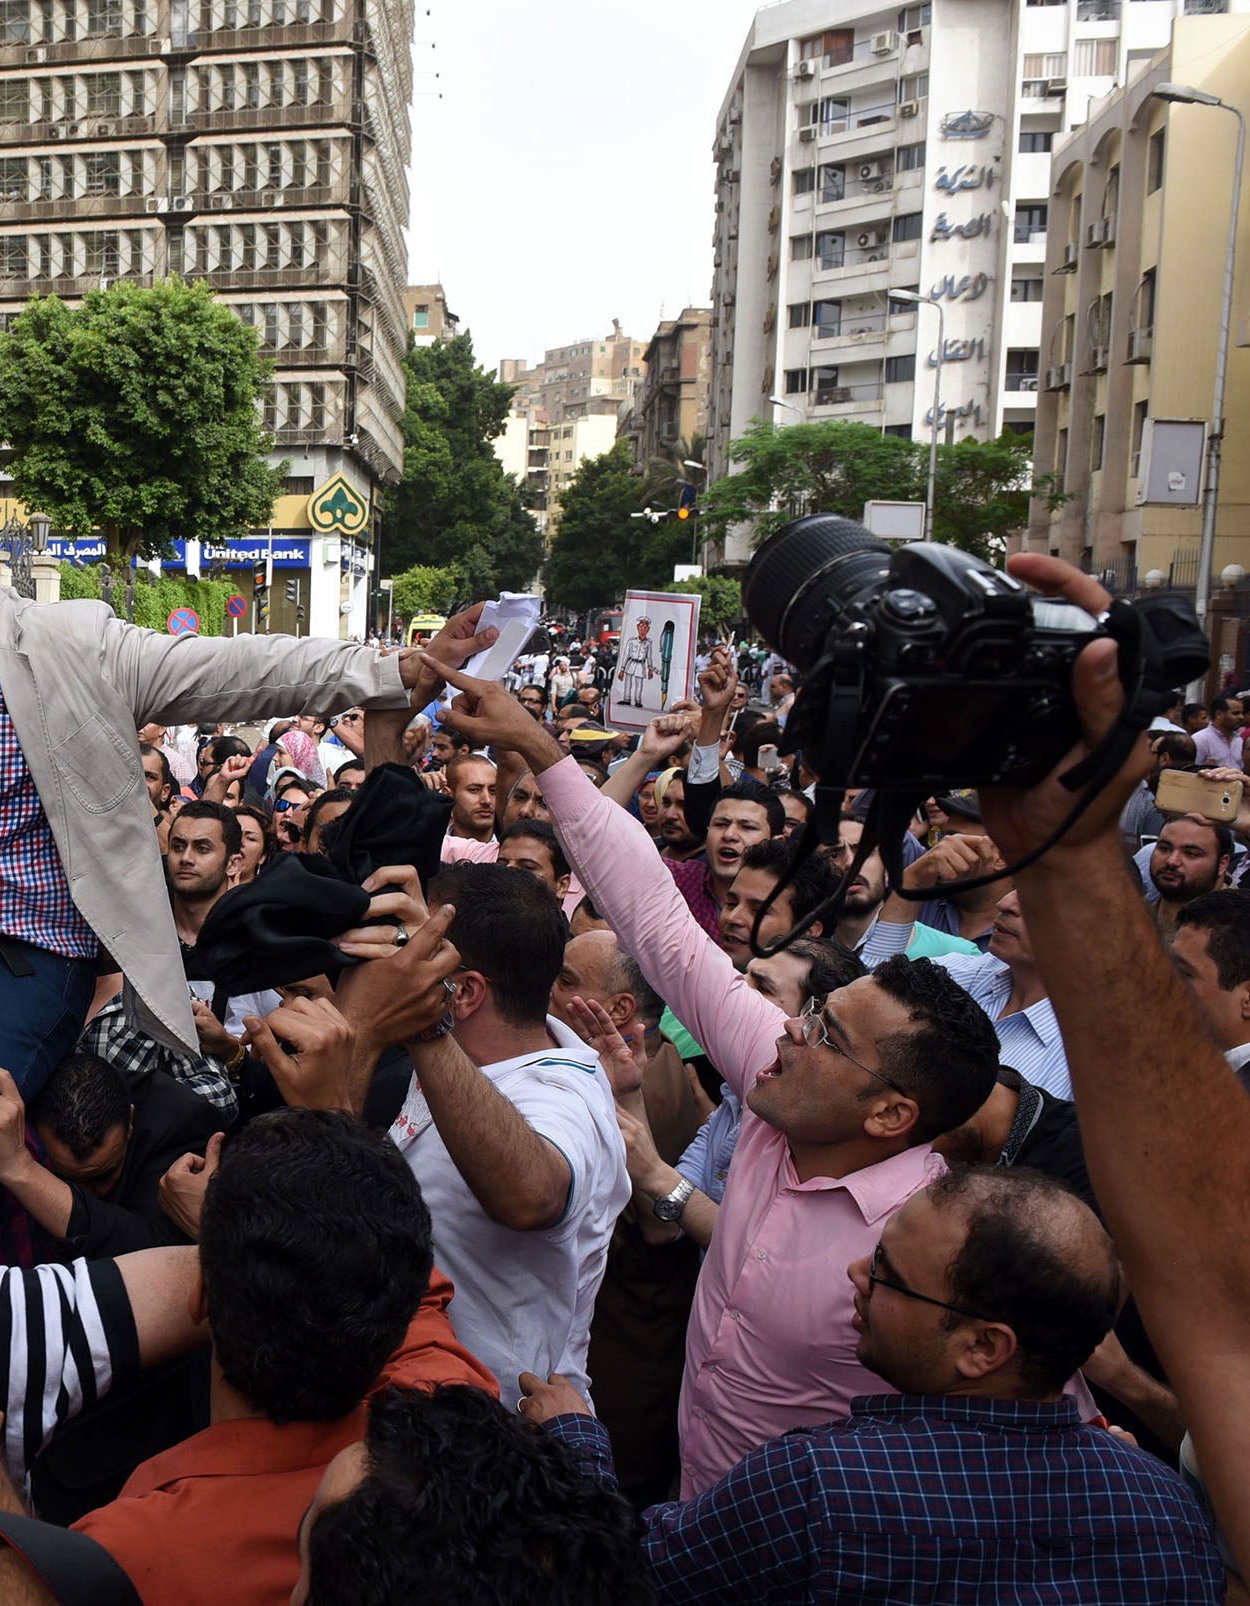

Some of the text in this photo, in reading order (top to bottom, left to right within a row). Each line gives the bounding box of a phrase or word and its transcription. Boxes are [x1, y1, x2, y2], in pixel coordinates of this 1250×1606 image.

[935, 164, 994, 196] الشركة
[63, 542, 107, 559] المصرف
[203, 549, 304, 560] United Bank
